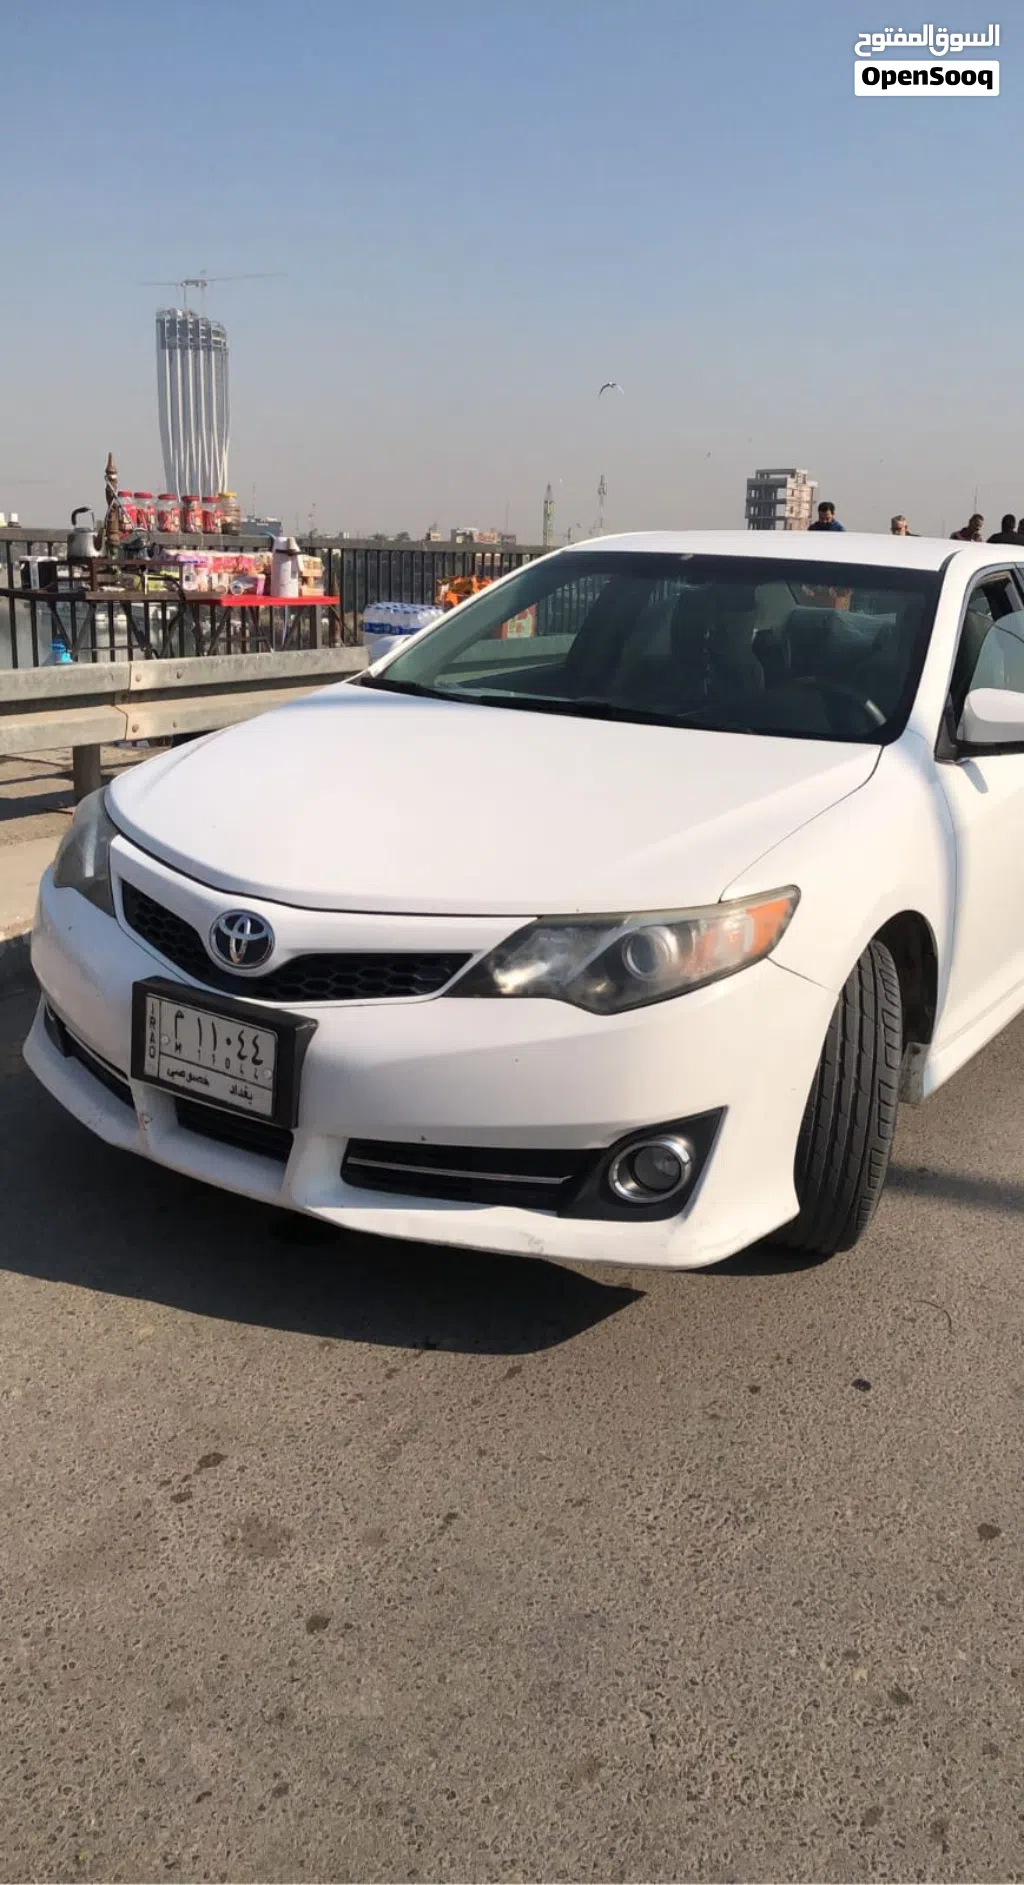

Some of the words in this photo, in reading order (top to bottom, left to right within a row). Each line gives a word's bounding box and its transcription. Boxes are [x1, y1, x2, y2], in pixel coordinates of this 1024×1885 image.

[148, 1002, 157, 1060] IRAQ
[197, 1017, 264, 1066] ١١٠٤٤
[167, 1067, 210, 1087] خصوصي
[229, 1084, 253, 1105] بغداد
